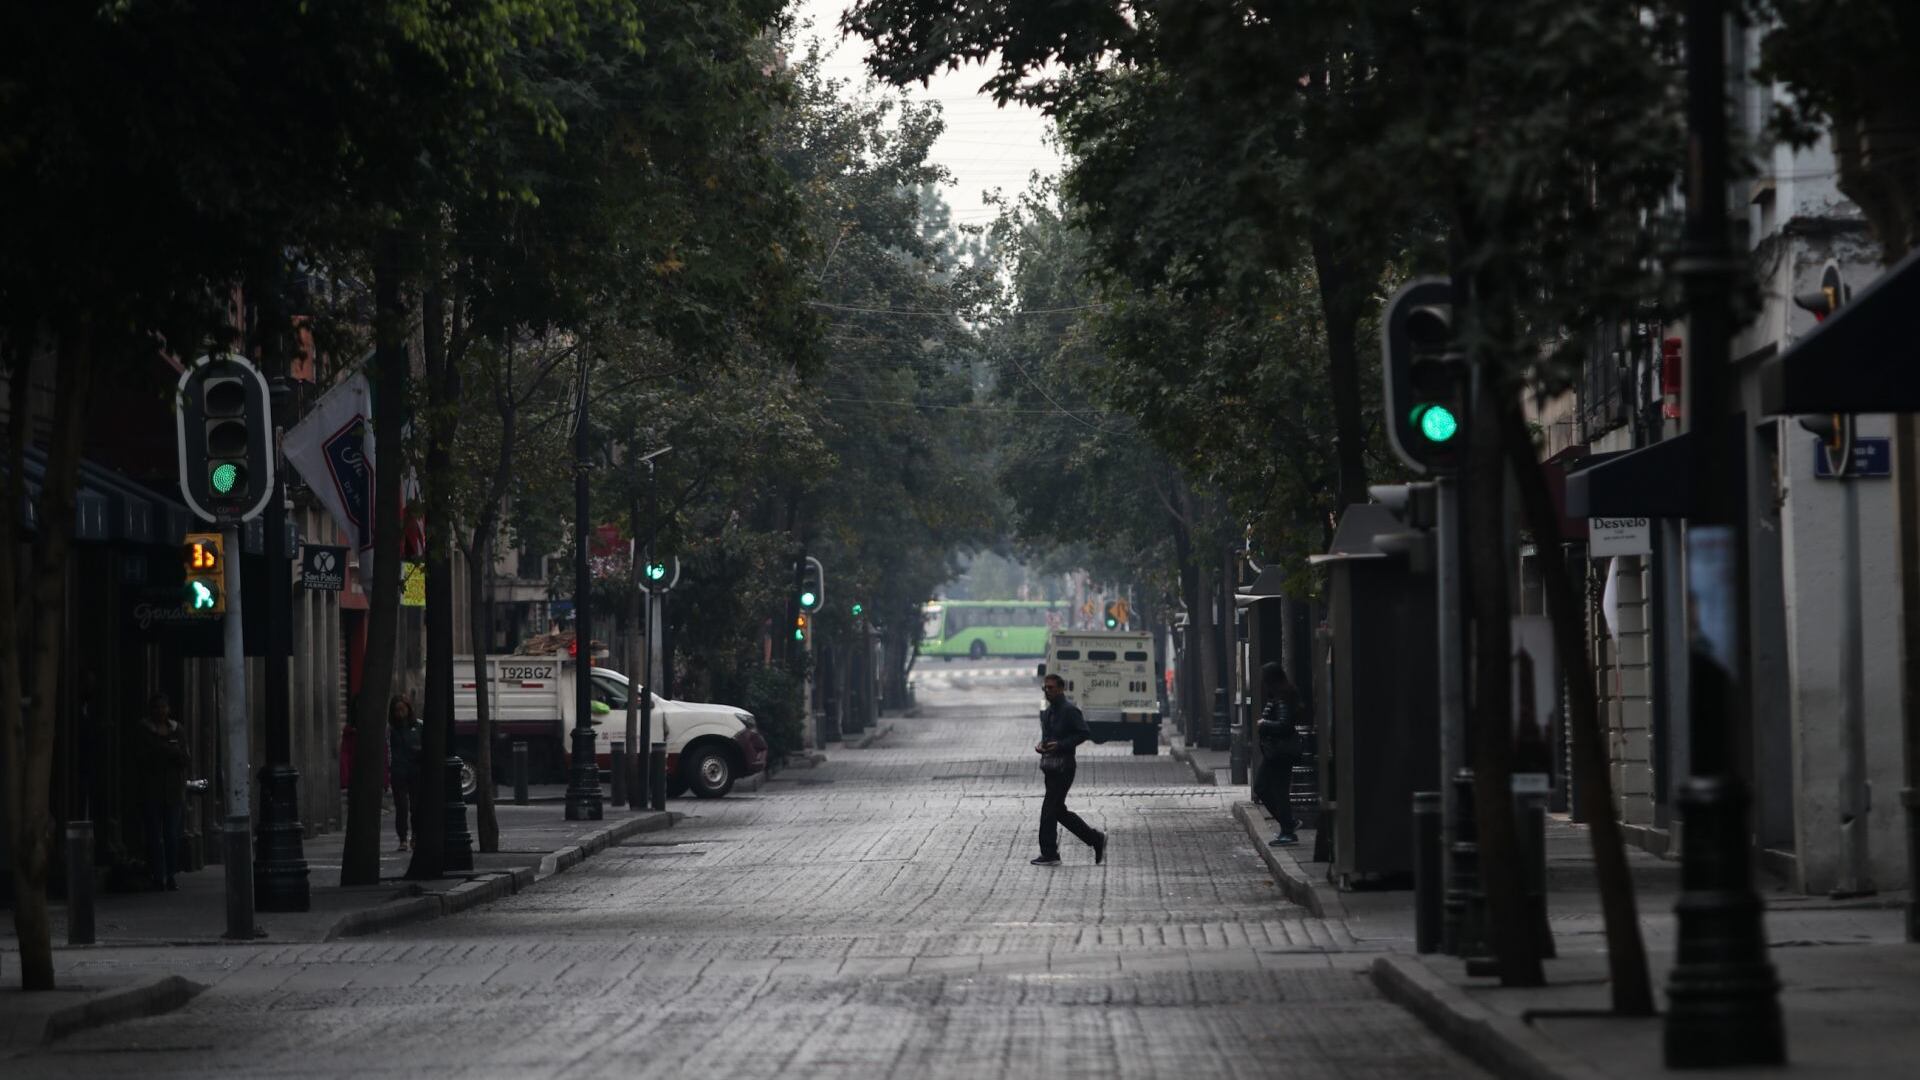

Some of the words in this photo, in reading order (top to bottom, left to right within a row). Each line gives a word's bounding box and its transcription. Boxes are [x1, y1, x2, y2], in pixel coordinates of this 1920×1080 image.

[1594, 517, 1647, 529] Desvelo
[304, 572, 319, 581] San
[320, 572, 342, 583] Pablo
[501, 667, 552, 679] T92BGZ
